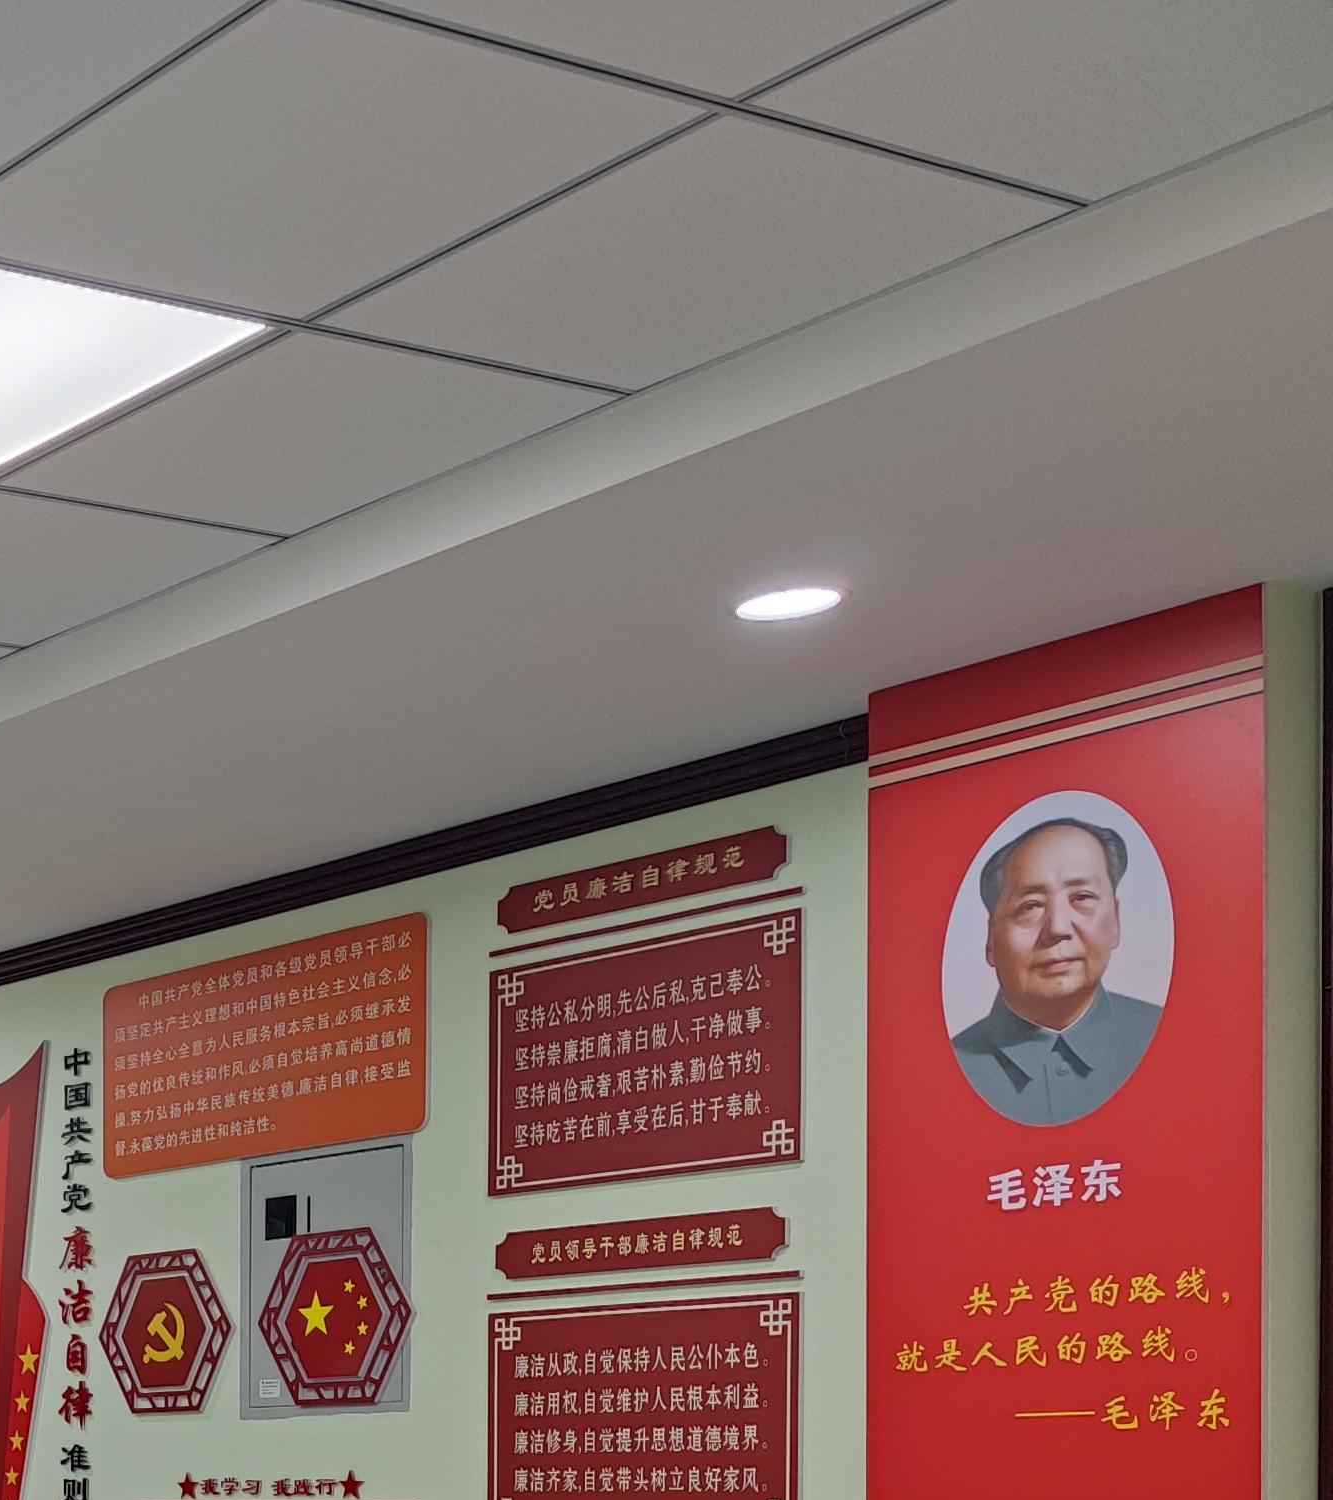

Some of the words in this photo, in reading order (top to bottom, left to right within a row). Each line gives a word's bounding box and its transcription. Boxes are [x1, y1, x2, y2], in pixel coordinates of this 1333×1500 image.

[533, 845, 745, 913] 党员廉洁自律规范
[138, 931, 412, 1010] 中国共产党全体党员和各级党员领导干部必
[115, 964, 412, 1043] 须坚定共产主义理想和中国特色社会主义信念,必
[515, 964, 771, 1033] 坚持公私分明,先公后私,克己奉公。
[115, 995, 412, 1072] 须坚持全心全意为人民服务根本宗旨,必须继承发
[515, 1005, 771, 1071] 坚持崇廉拒腐,清白做人,干净做事。
[115, 1027, 412, 1101] 扬党的优良传统和作风,必须自觉培养高尚道德情
[515, 1048, 771, 1110] 坚持尚俭戒奢,艰苦朴素,勤俭节约。
[115, 1115, 276, 1157] 督,永葆党的先进性和纯洁性。
[514, 1090, 771, 1149] 坚持吃苦在前,享受在后,甘于奉献。
[987, 1159, 1123, 1211] 毛泽东
[531, 1224, 743, 1264] 党员领导干部廉洁自律规范
[963, 1266, 1234, 1317] 共产党的路线，
[513, 1342, 769, 1379] 廉洁从政,自觉保持人民公仆本色。
[895, 1325, 1199, 1373] 就是人民的路线。
[513, 1383, 769, 1417] 廉洁用权,自觉维护人民根本利益。
[513, 1424, 769, 1456] 廉洁修身,自觉提升思想道德境界。
[199, 1477, 262, 1496] 我学习
[271, 1477, 338, 1497] 我践行
[513, 1465, 769, 1494] 廉洁齐家,自觉带头树立良好家风。
